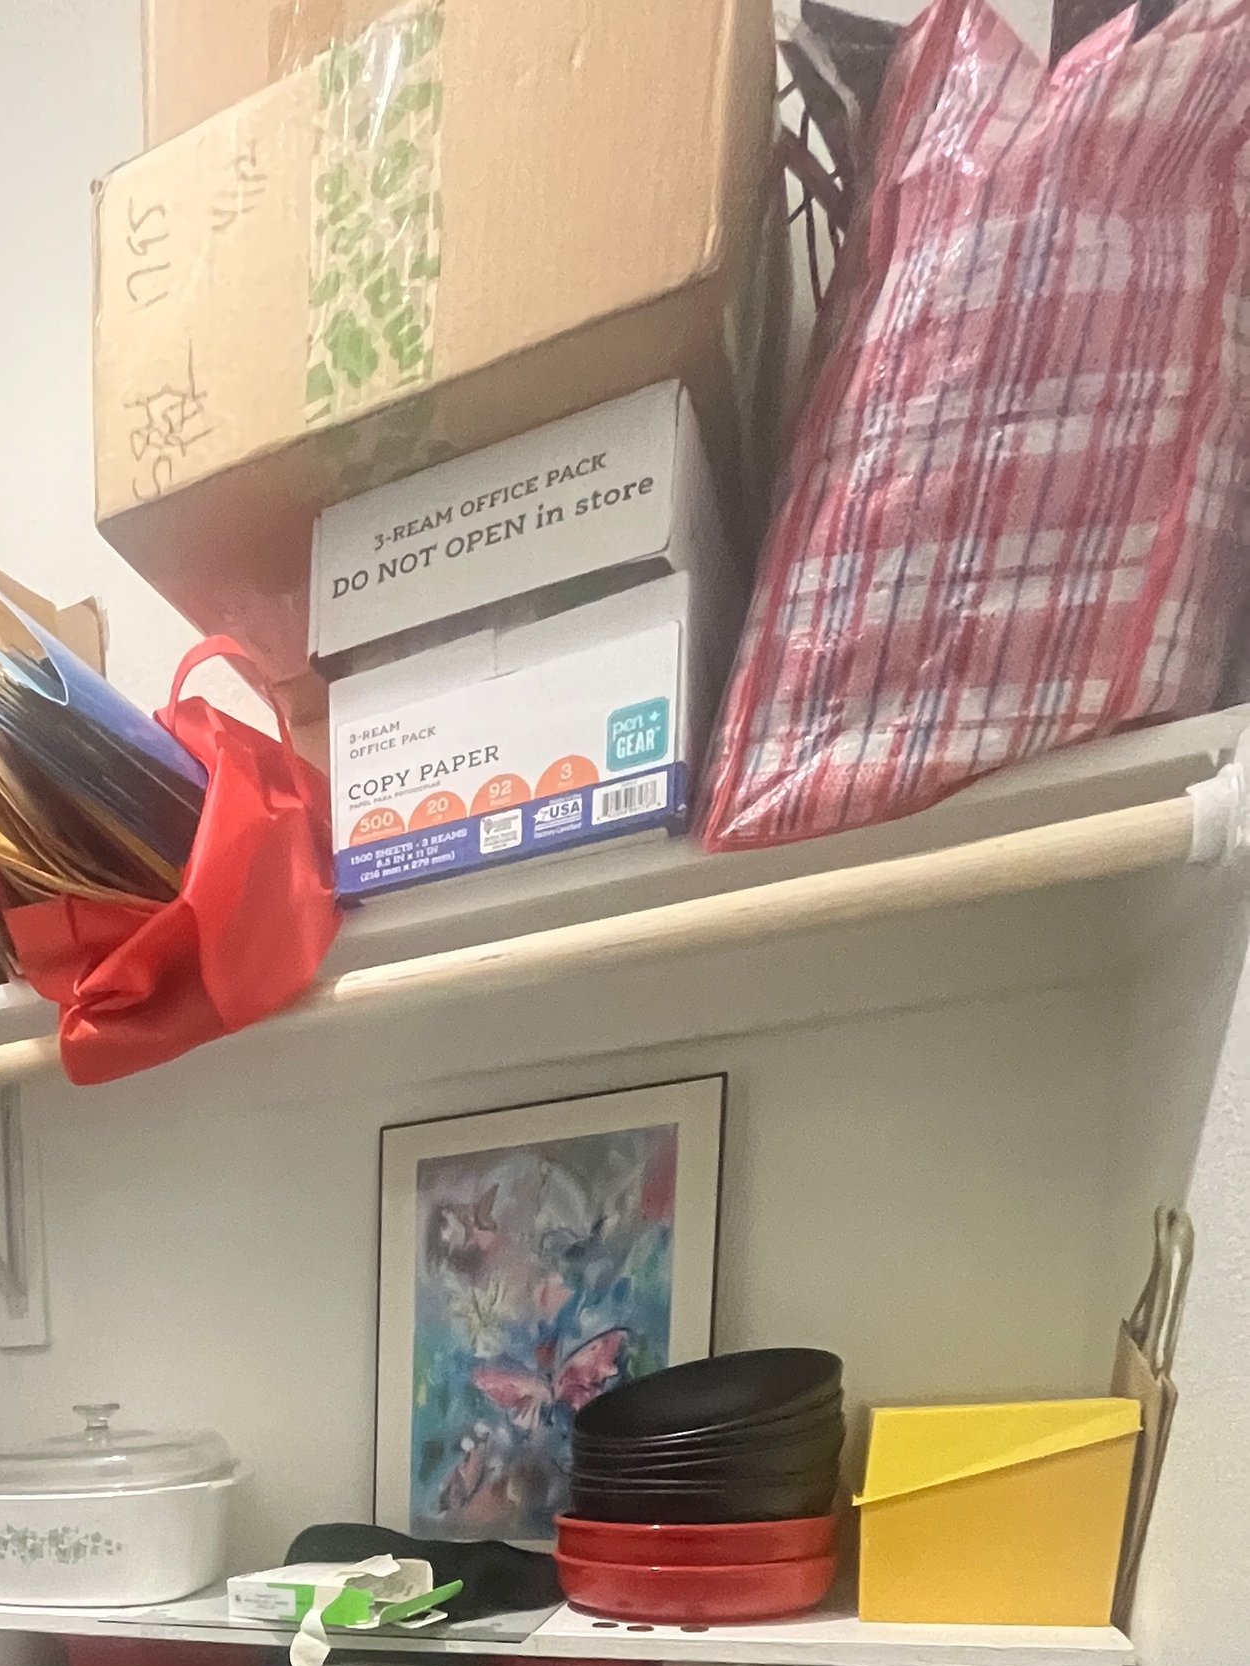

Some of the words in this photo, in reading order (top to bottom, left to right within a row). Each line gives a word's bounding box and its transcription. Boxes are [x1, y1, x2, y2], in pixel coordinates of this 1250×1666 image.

[373, 507, 453, 551] 3-REAM
[459, 476, 539, 518] OFFICE
[544, 451, 607, 489] PACK
[332, 569, 369, 600] DO
[377, 542, 439, 585] NOT
[445, 513, 526, 559] OPEN
[534, 503, 564, 530] in
[574, 475, 655, 518] store
[349, 720, 401, 746] 3-REAM
[349, 736, 397, 760] OFFICE
[401, 725, 437, 745] PACK
[616, 727, 656, 760] GEAR
[348, 767, 411, 801] COPY
[419, 744, 501, 783] PAPER
[559, 762, 573, 780] 3
[488, 779, 513, 799] 92
[426, 797, 449, 816] 20
[548, 800, 581, 819] USA
[358, 810, 395, 834] 500
[431, 828, 468, 845] REAMS
